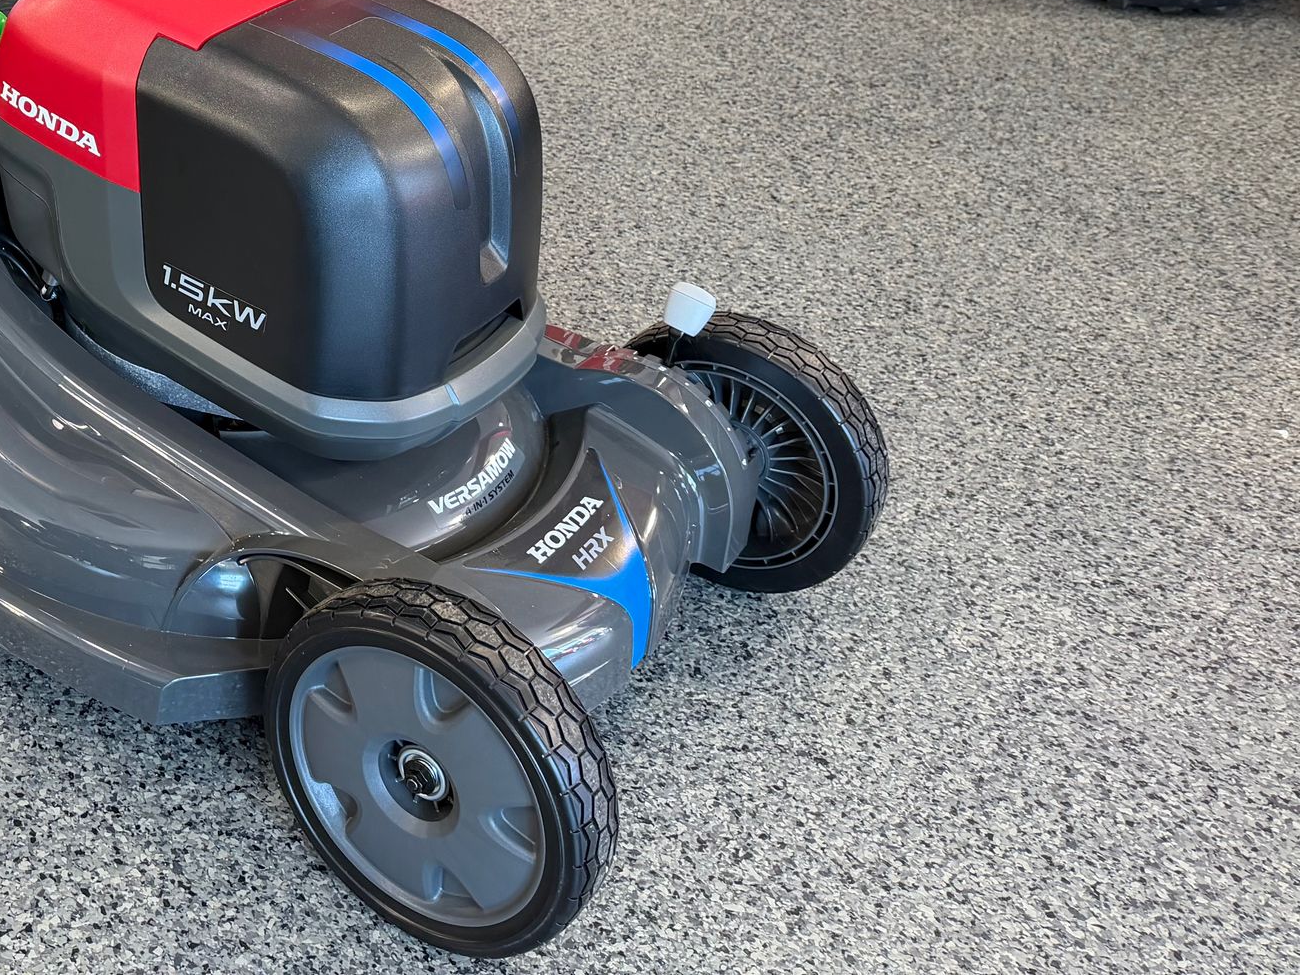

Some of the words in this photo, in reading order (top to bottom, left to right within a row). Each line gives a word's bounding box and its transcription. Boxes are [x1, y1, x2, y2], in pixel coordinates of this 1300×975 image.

[0, 81, 101, 158] HONDA
[188, 303, 228, 331] MAX
[427, 437, 516, 515] VERSAMOW
[488, 469, 515, 501] SYSTEM
[526, 495, 604, 564] HONDA
[572, 526, 615, 571] HRX
